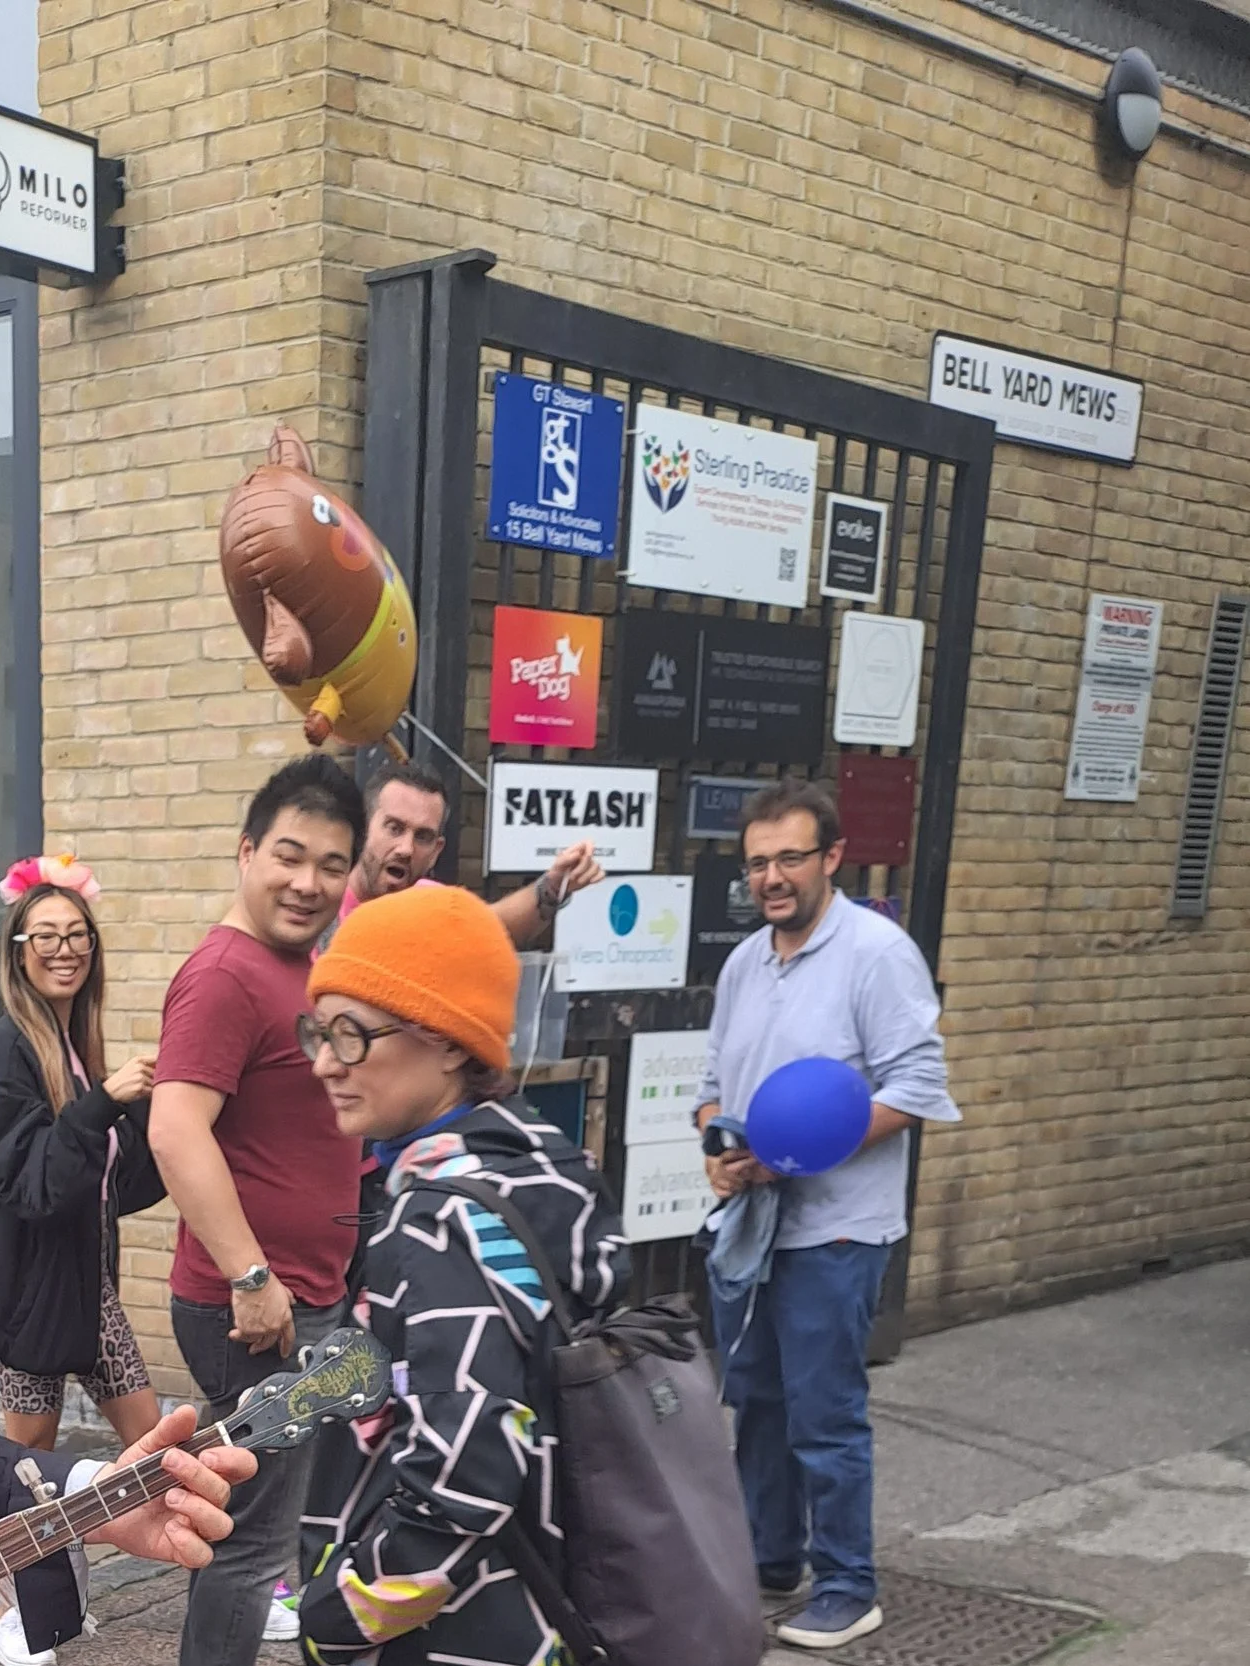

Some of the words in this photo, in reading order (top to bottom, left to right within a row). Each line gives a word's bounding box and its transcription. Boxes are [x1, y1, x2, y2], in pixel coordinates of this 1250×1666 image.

[19, 165, 87, 208] MILO
[19, 200, 88, 232] REFORMER
[532, 384, 551, 402] GT
[552, 387, 594, 414] Stewart
[942, 353, 992, 395] BELL
[1002, 365, 1053, 407] YARD
[1058, 379, 1118, 422] MEWS
[694, 448, 750, 489] Sterling
[753, 460, 811, 495] Practice
[508, 501, 550, 521] Solicitors
[551, 509, 559, 524] &
[558, 512, 602, 533] Advocates
[506, 519, 521, 539] 15
[522, 521, 544, 543] Bell
[547, 526, 571, 547] Yard
[572, 530, 603, 553] Mews
[1102, 605, 1153, 627] WARNING
[510, 653, 560, 686] Paper
[537, 674, 571, 701] Dog
